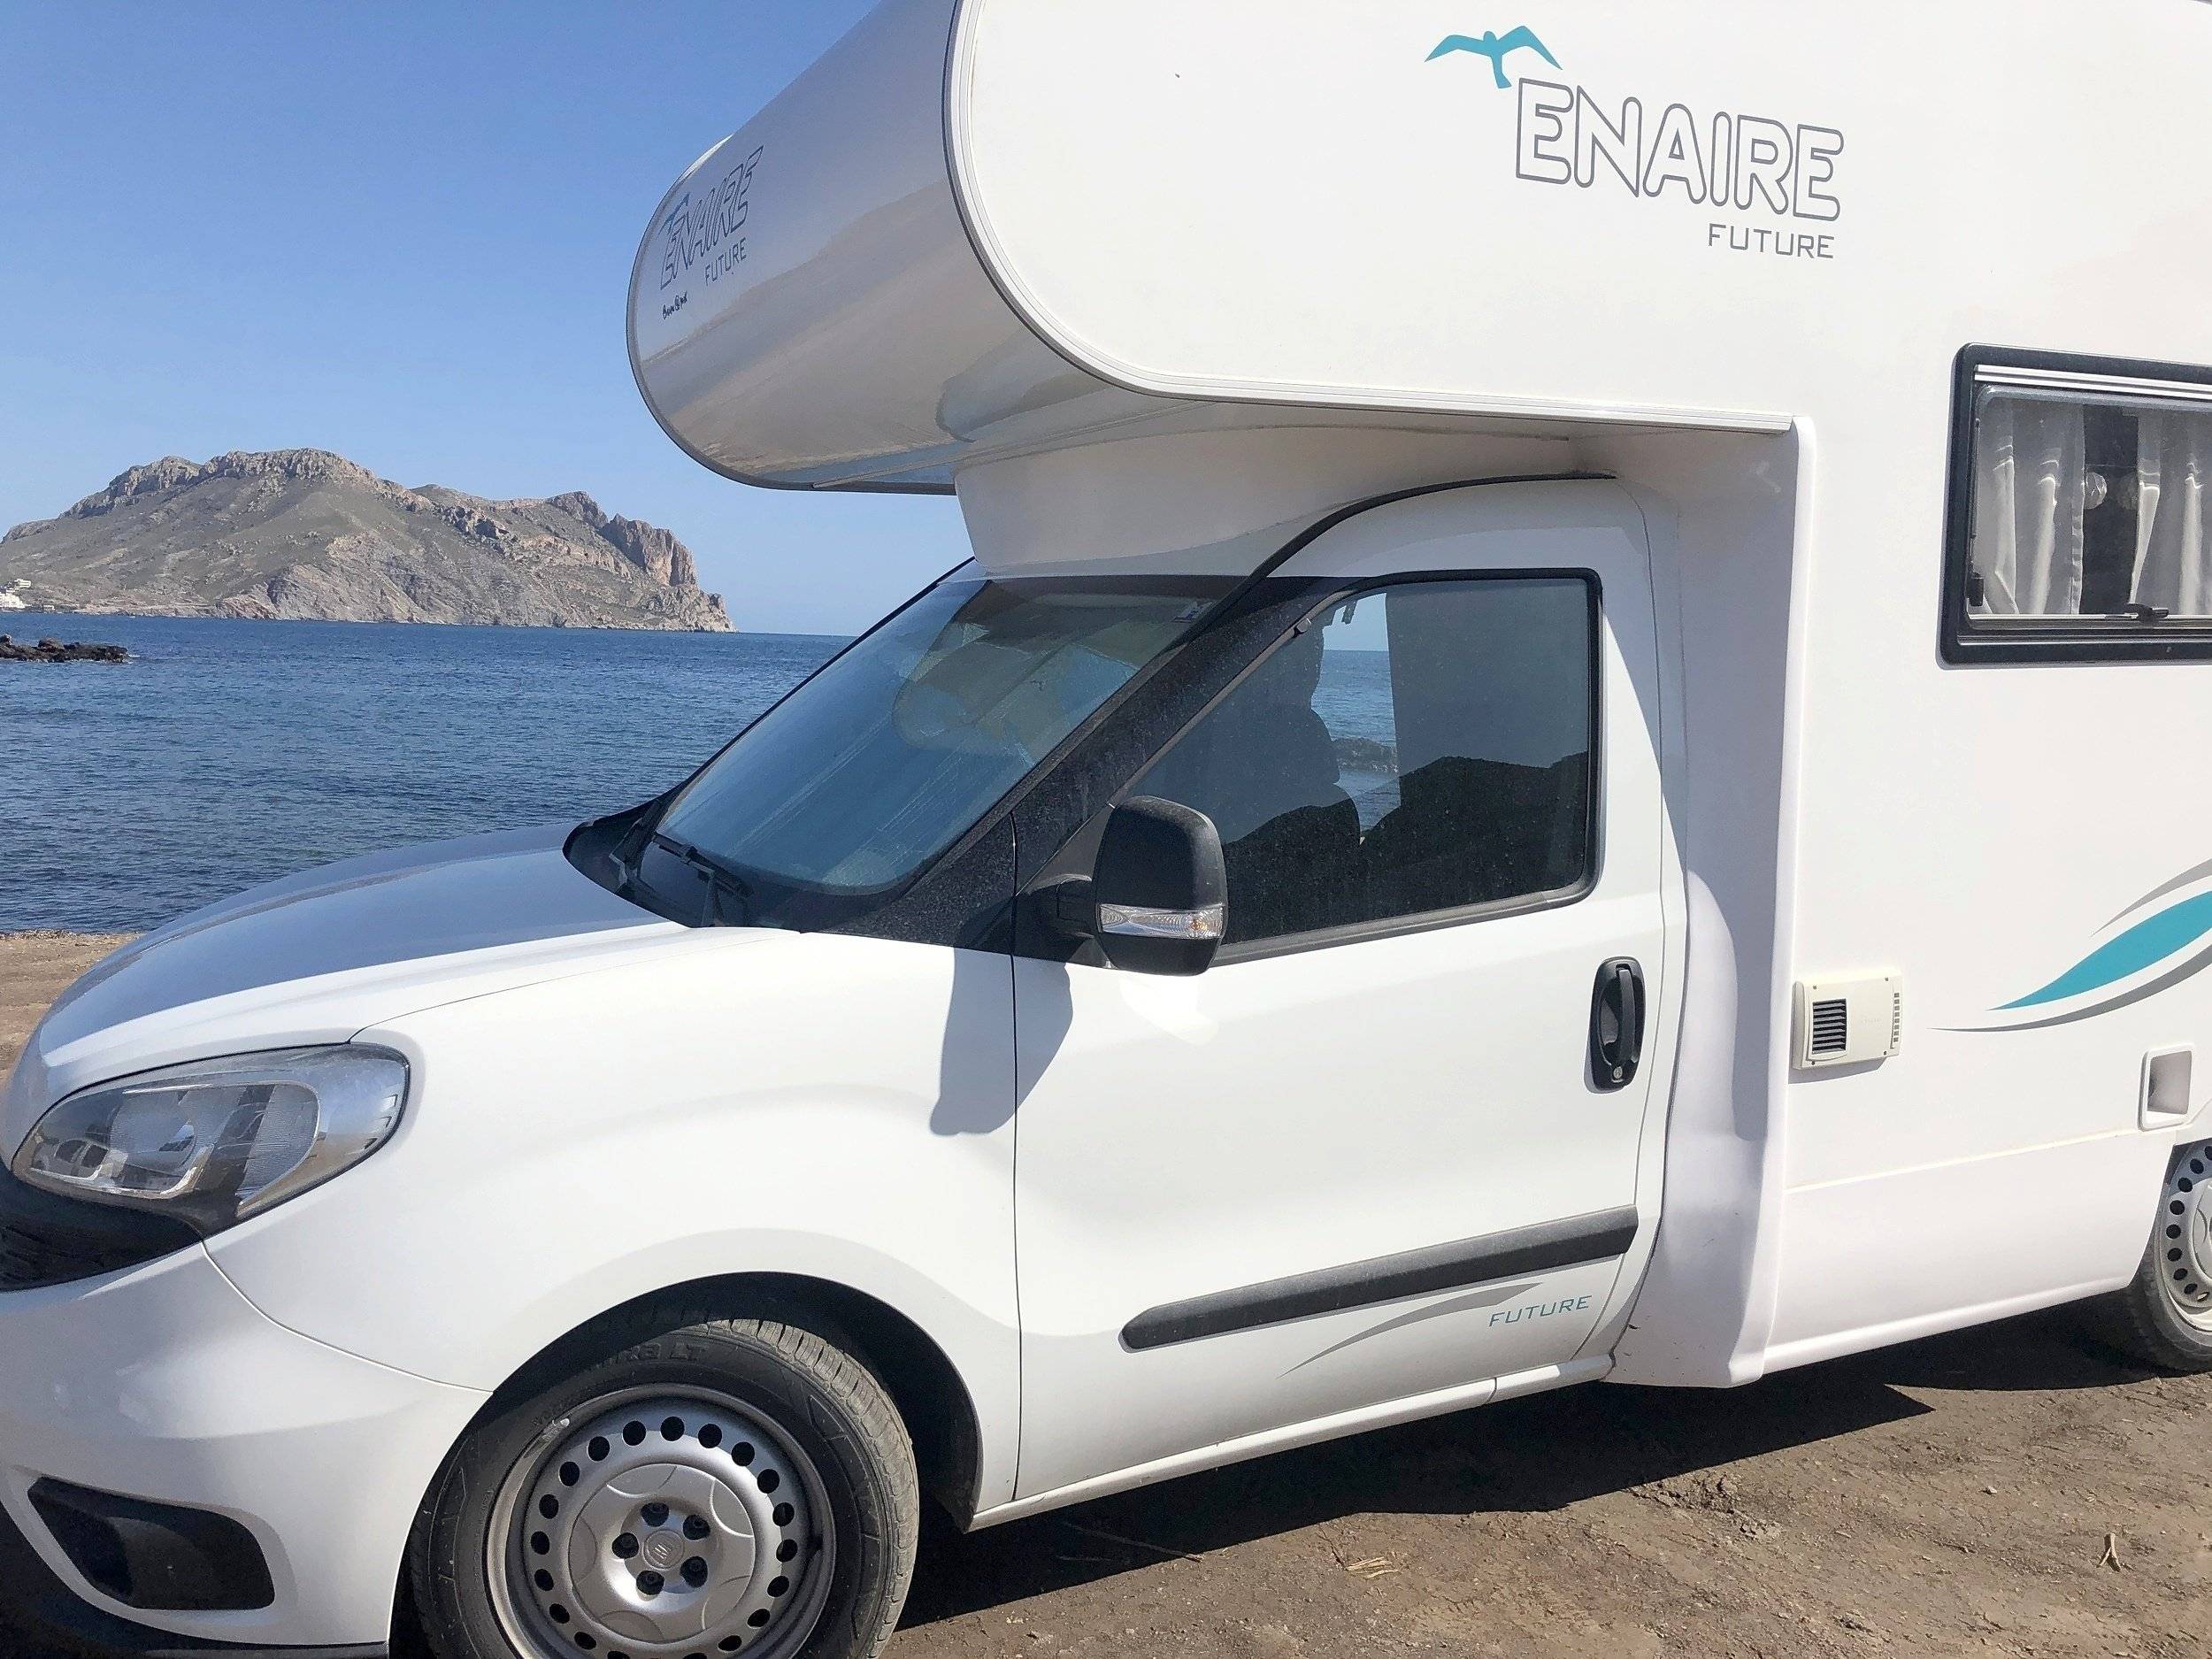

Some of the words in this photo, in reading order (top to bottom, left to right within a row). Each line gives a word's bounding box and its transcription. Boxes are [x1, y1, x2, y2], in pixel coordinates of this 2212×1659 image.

[1515, 77, 1845, 222] ENAIRE
[660, 145, 764, 291] ENAIRE
[1708, 223, 1835, 259] FUTURE
[704, 237, 747, 286] FUTURE
[1488, 1294, 1593, 1328] FUTURE
